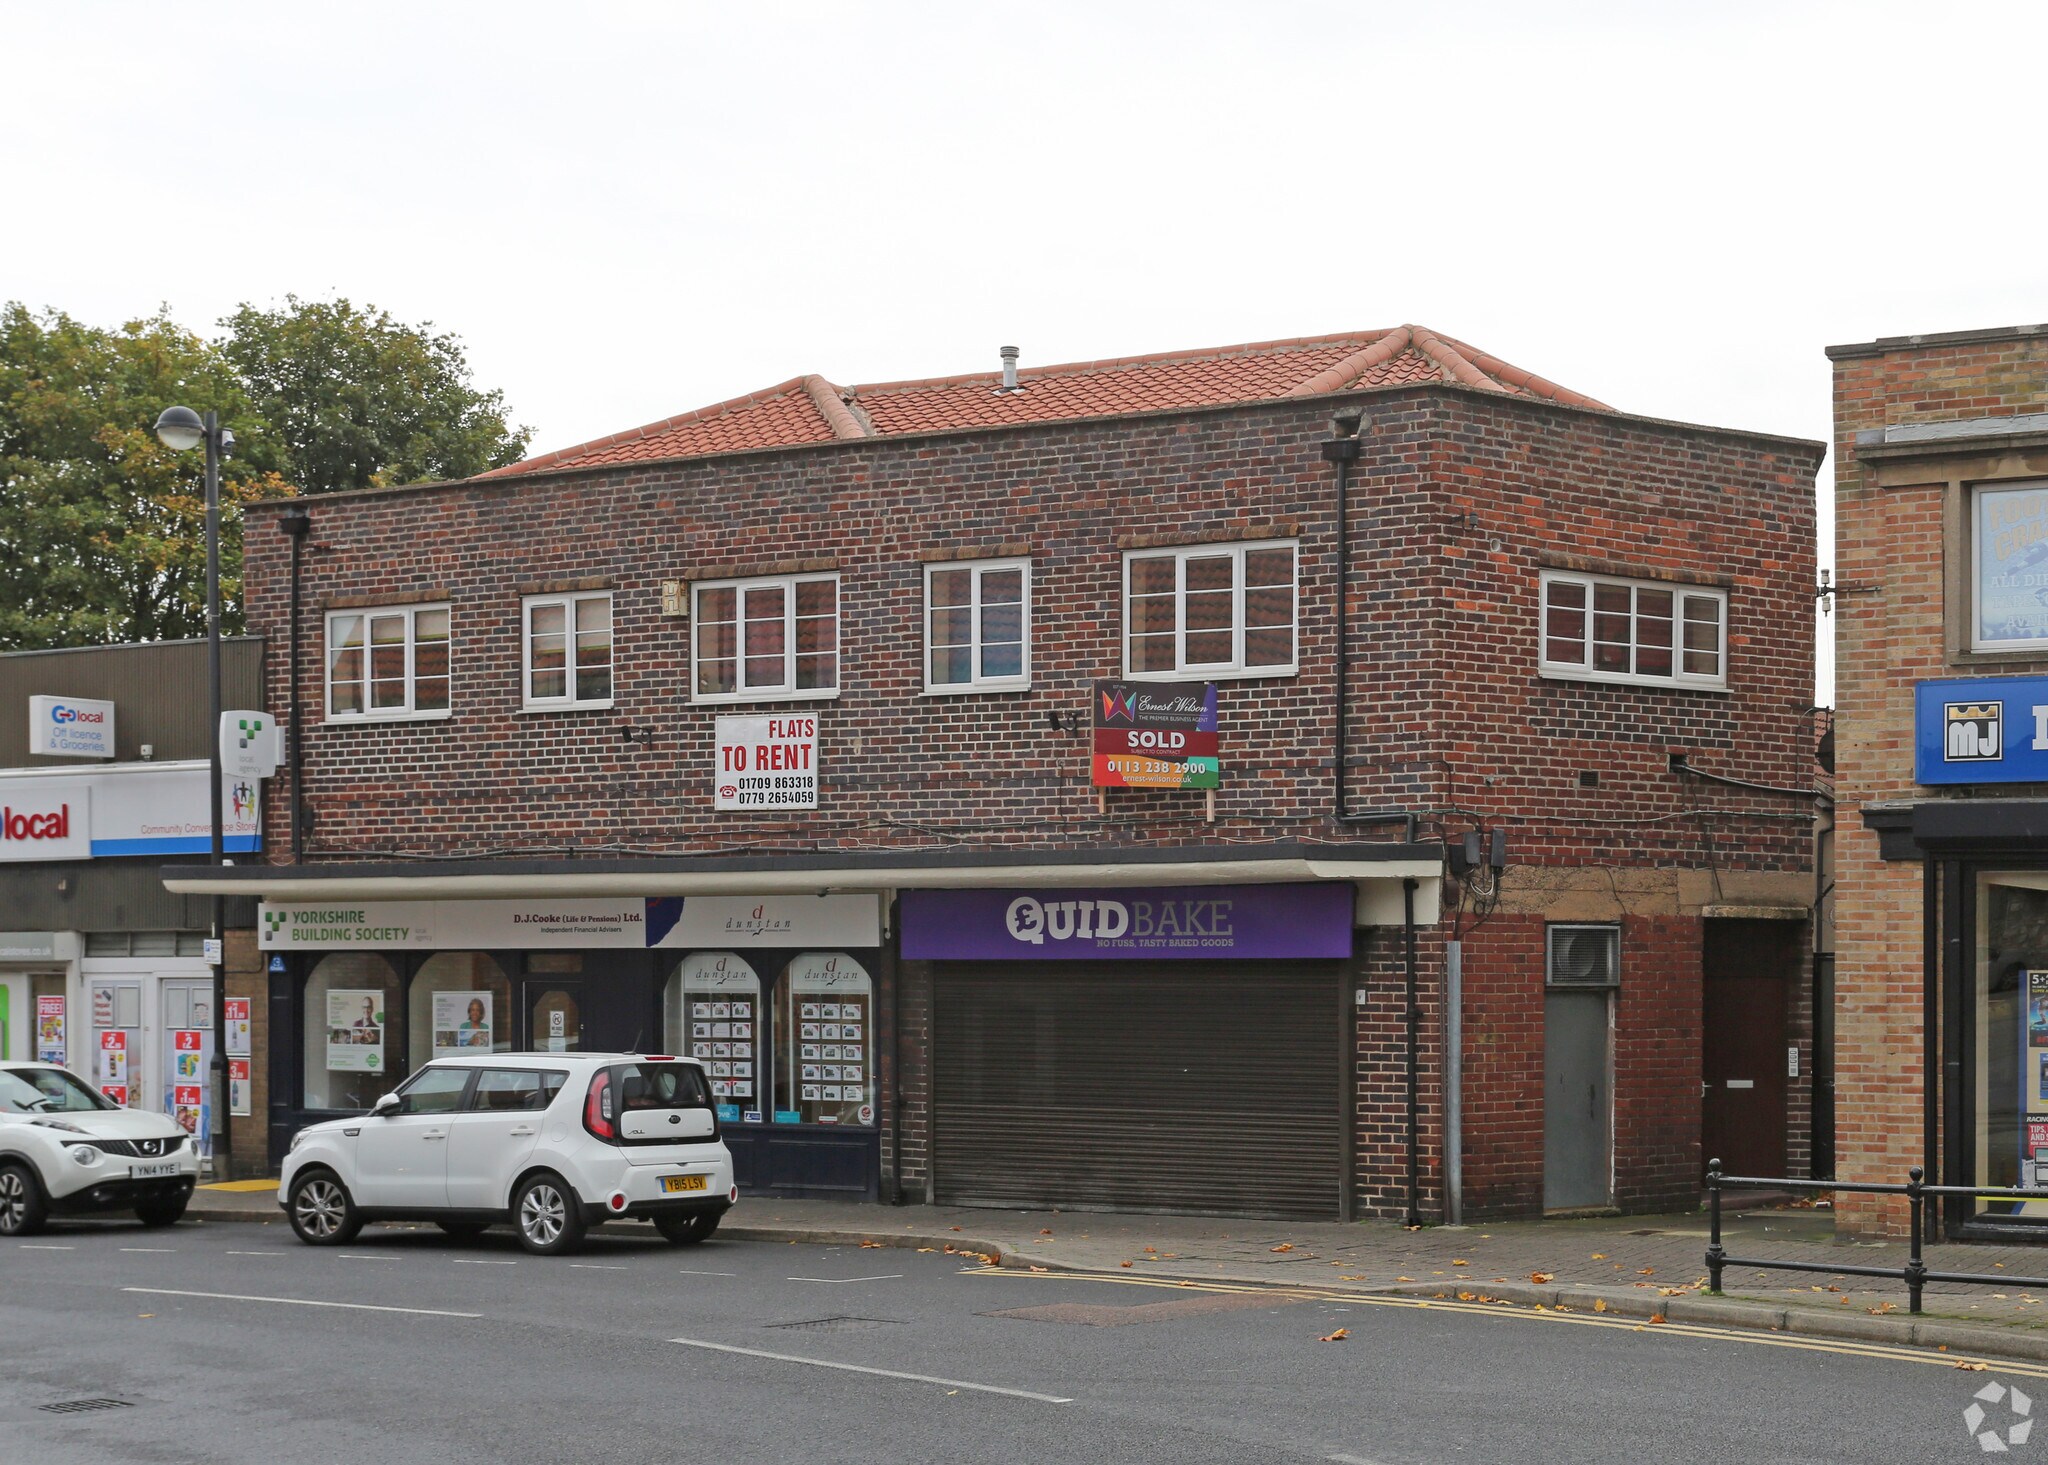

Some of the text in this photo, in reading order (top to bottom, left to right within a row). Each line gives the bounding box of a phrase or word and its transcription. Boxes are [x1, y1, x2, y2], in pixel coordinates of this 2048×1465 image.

[1994, 519, 2048, 561] CRA
[1991, 575, 2019, 588] ALL
[1139, 695, 1208, 713] Ernest Wilson
[77, 710, 103, 723] local
[53, 727, 102, 740] Off licence
[769, 719, 814, 738] FLATS
[51, 738, 105, 751] & Groceries
[1127, 731, 1185, 748] SOLD
[722, 744, 811, 771] TO RENT
[1108, 761, 1206, 774] 0113 238 2900
[739, 776, 813, 789] 01709 863318
[739, 791, 814, 804] 0779 2654059
[4, 804, 69, 841] local
[141, 824, 183, 835] Community
[236, 821, 257, 832] Store
[293, 911, 365, 924] YORKSHIRE
[513, 914, 561, 923] D.J.Cooke
[562, 914, 579, 923] (Life
[588, 914, 622, 923] Pensions)
[623, 913, 643, 922] Ltd.
[725, 917, 791, 929] dunstan
[292, 927, 409, 941] BUILDING SOCIETY
[1097, 938, 1234, 948] NO FUSS, TASTY BAKED GOODS
[159, 1164, 175, 1174] YYE
[669, 1178, 704, 1190] YB15 LSV
